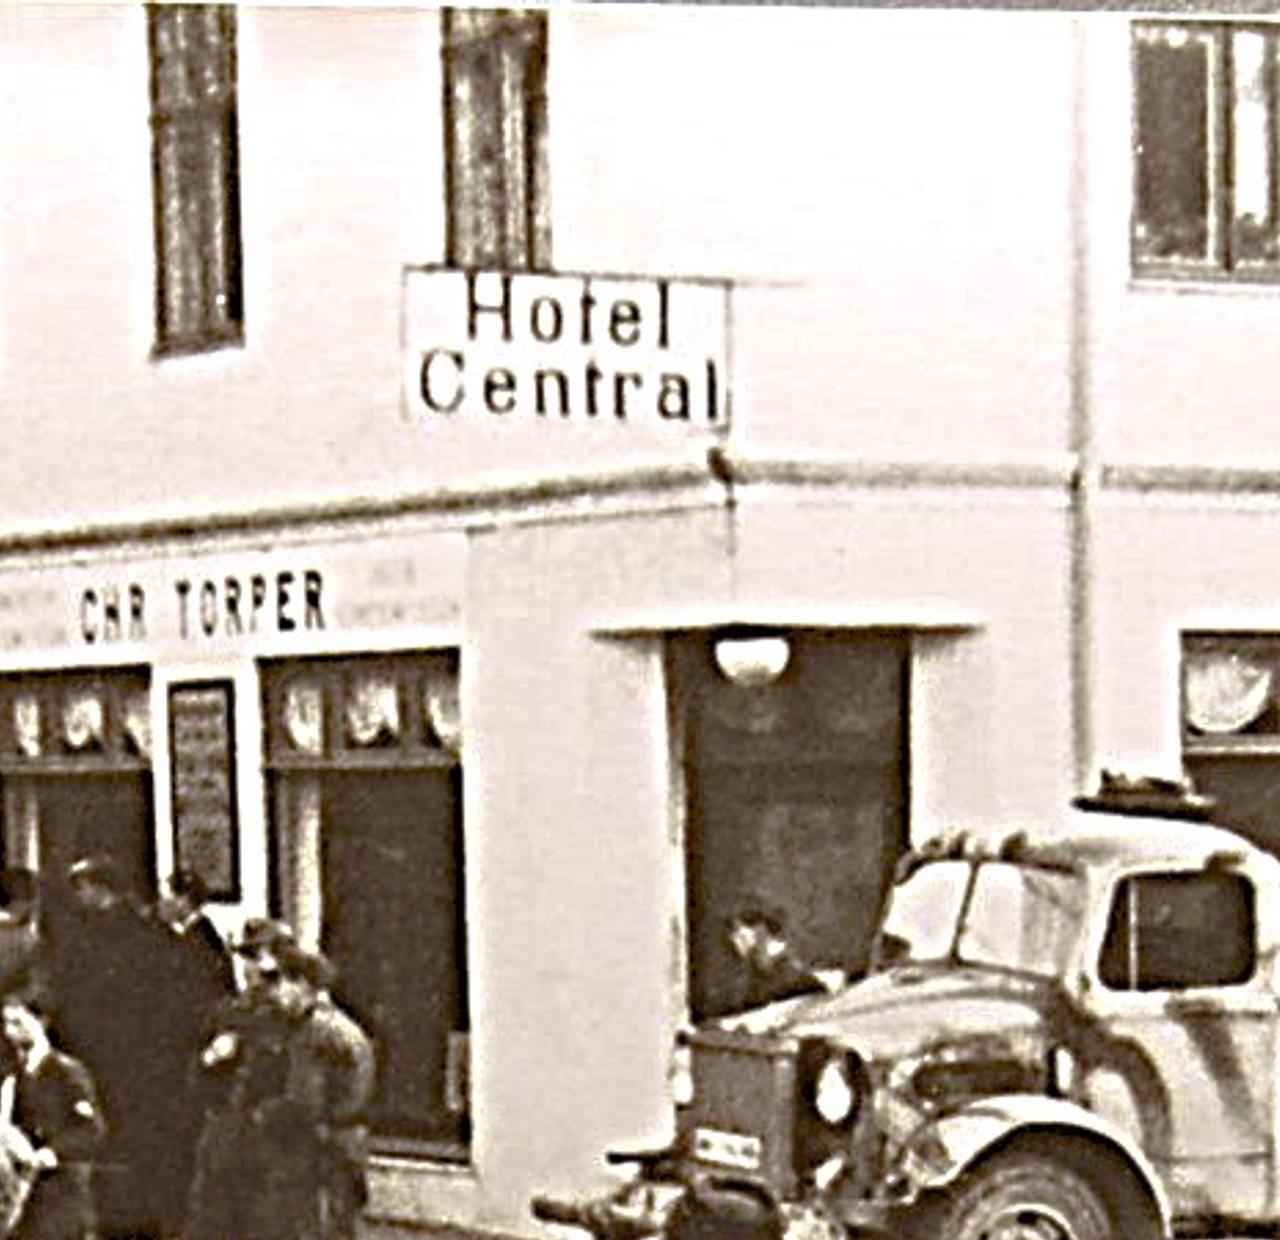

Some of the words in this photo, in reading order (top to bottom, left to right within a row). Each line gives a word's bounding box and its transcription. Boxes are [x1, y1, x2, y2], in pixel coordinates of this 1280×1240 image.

[465, 271, 669, 348] Hotel
[420, 348, 718, 421] Central
[81, 583, 146, 644] CHR
[175, 570, 325, 640] TORPER
